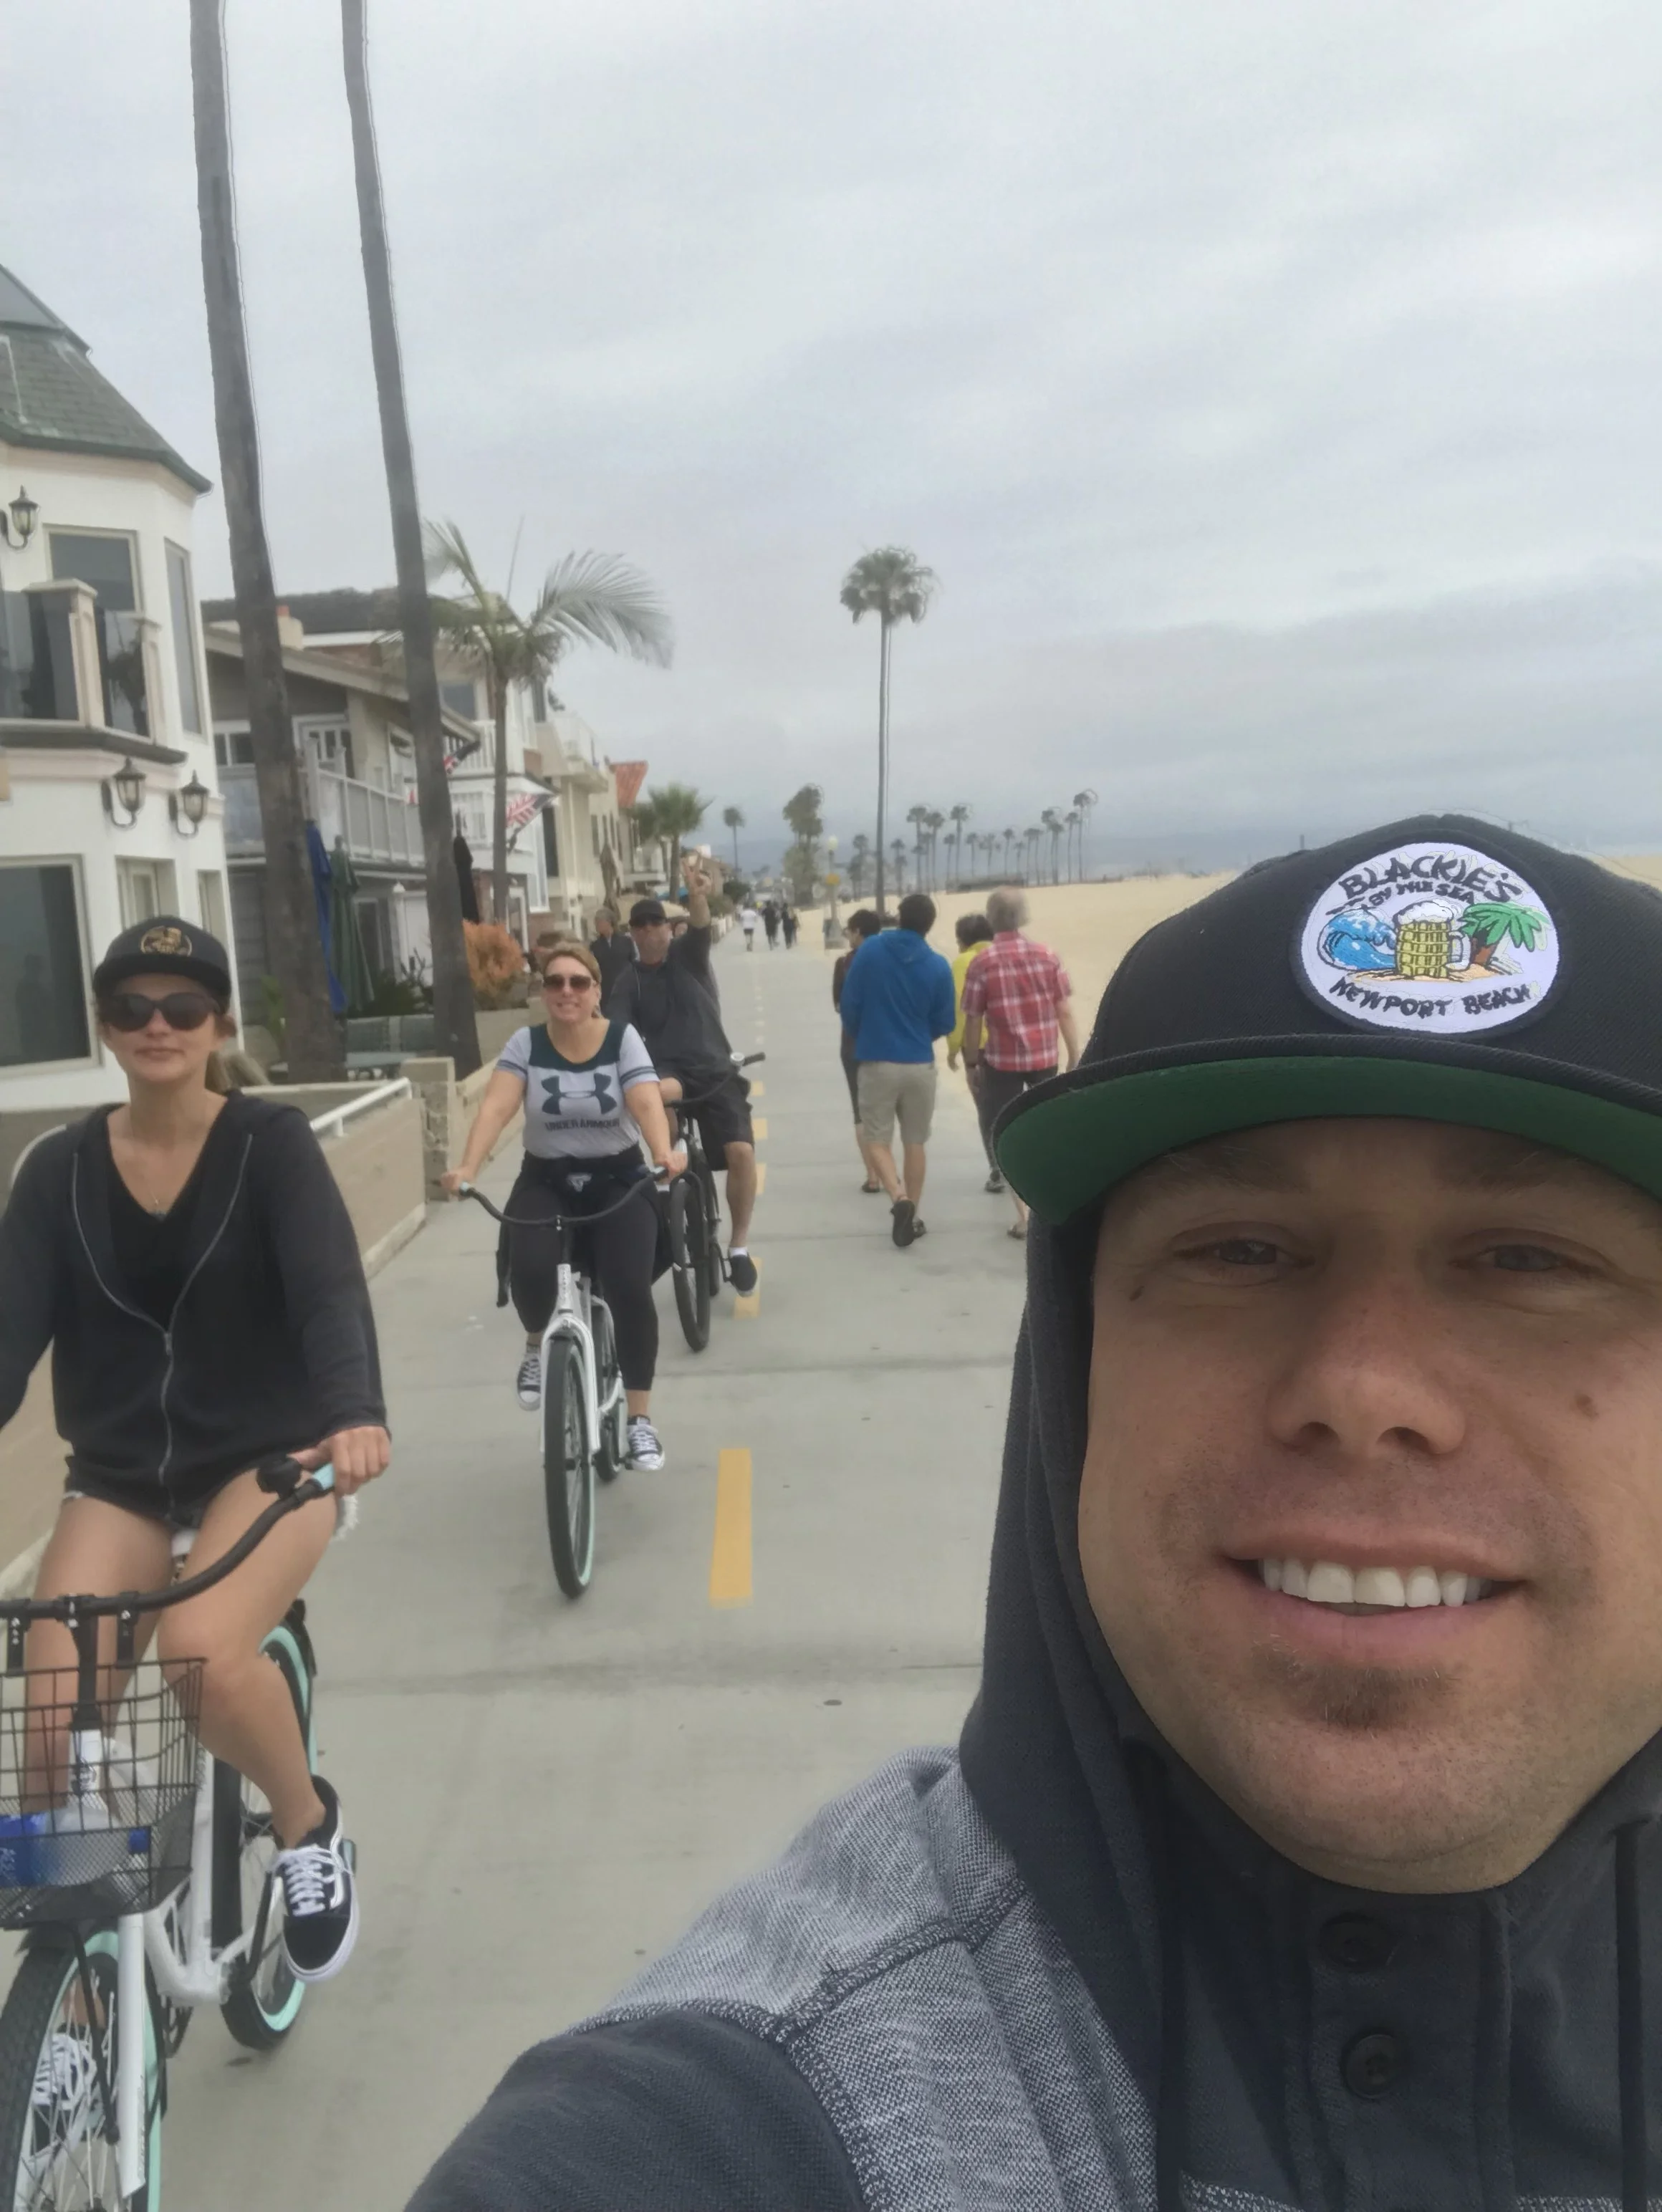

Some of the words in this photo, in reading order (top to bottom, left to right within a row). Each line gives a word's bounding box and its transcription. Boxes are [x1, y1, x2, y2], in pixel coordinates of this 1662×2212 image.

[1338, 855, 1523, 903] BLACKIE'S
[1369, 886, 1392, 906] BY
[1396, 881, 1433, 895] THE
[1435, 883, 1475, 905] SEA
[1329, 976, 1453, 1019] NEWPORT
[1461, 984, 1531, 1015] BEACH
[544, 1119, 580, 1133] UNDER
[580, 1118, 620, 1130] ARMOUR
